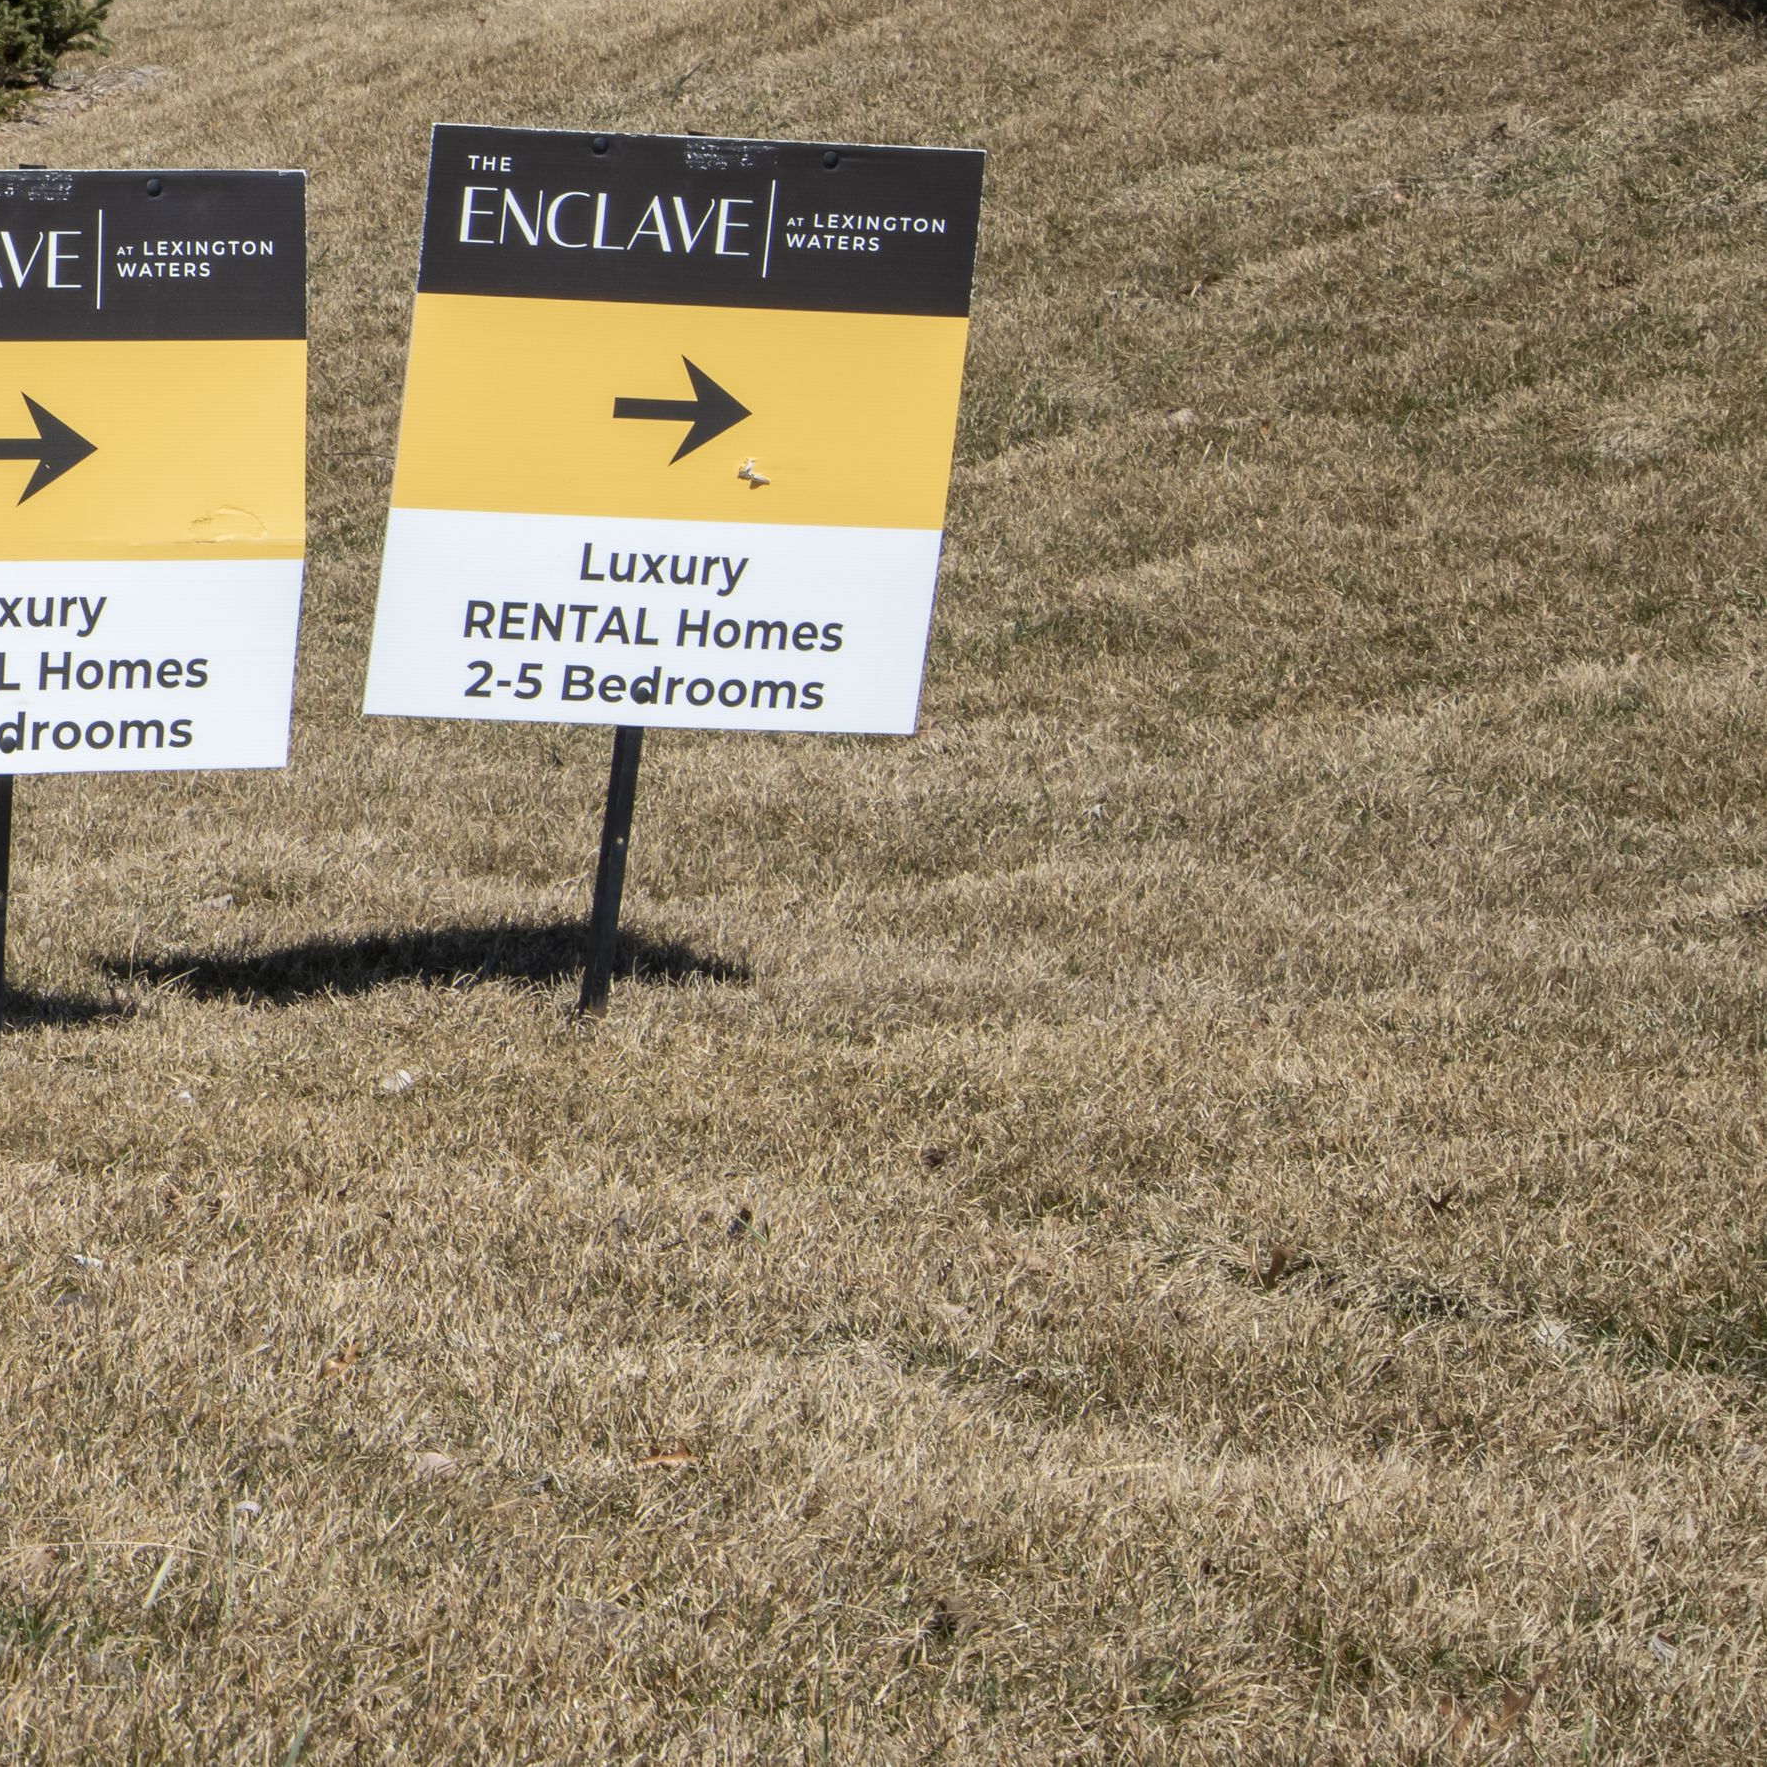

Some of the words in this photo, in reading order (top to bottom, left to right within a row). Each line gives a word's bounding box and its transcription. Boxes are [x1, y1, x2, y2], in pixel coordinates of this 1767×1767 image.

[468, 155, 512, 172] THE
[458, 186, 754, 257] ENCLAVE
[786, 217, 805, 228] AT
[813, 212, 947, 234] LEXINGTON
[116, 245, 134, 256] AT
[143, 240, 275, 257] LEXINGTON
[786, 233, 881, 253] WATERS
[117, 262, 212, 279] WATERS
[579, 542, 750, 597] Luxury
[463, 600, 659, 646] RENTAL
[675, 608, 844, 653] Homes
[38, 651, 209, 691] Homes
[464, 660, 543, 698] 2-5
[561, 664, 825, 711] Bedrooms
